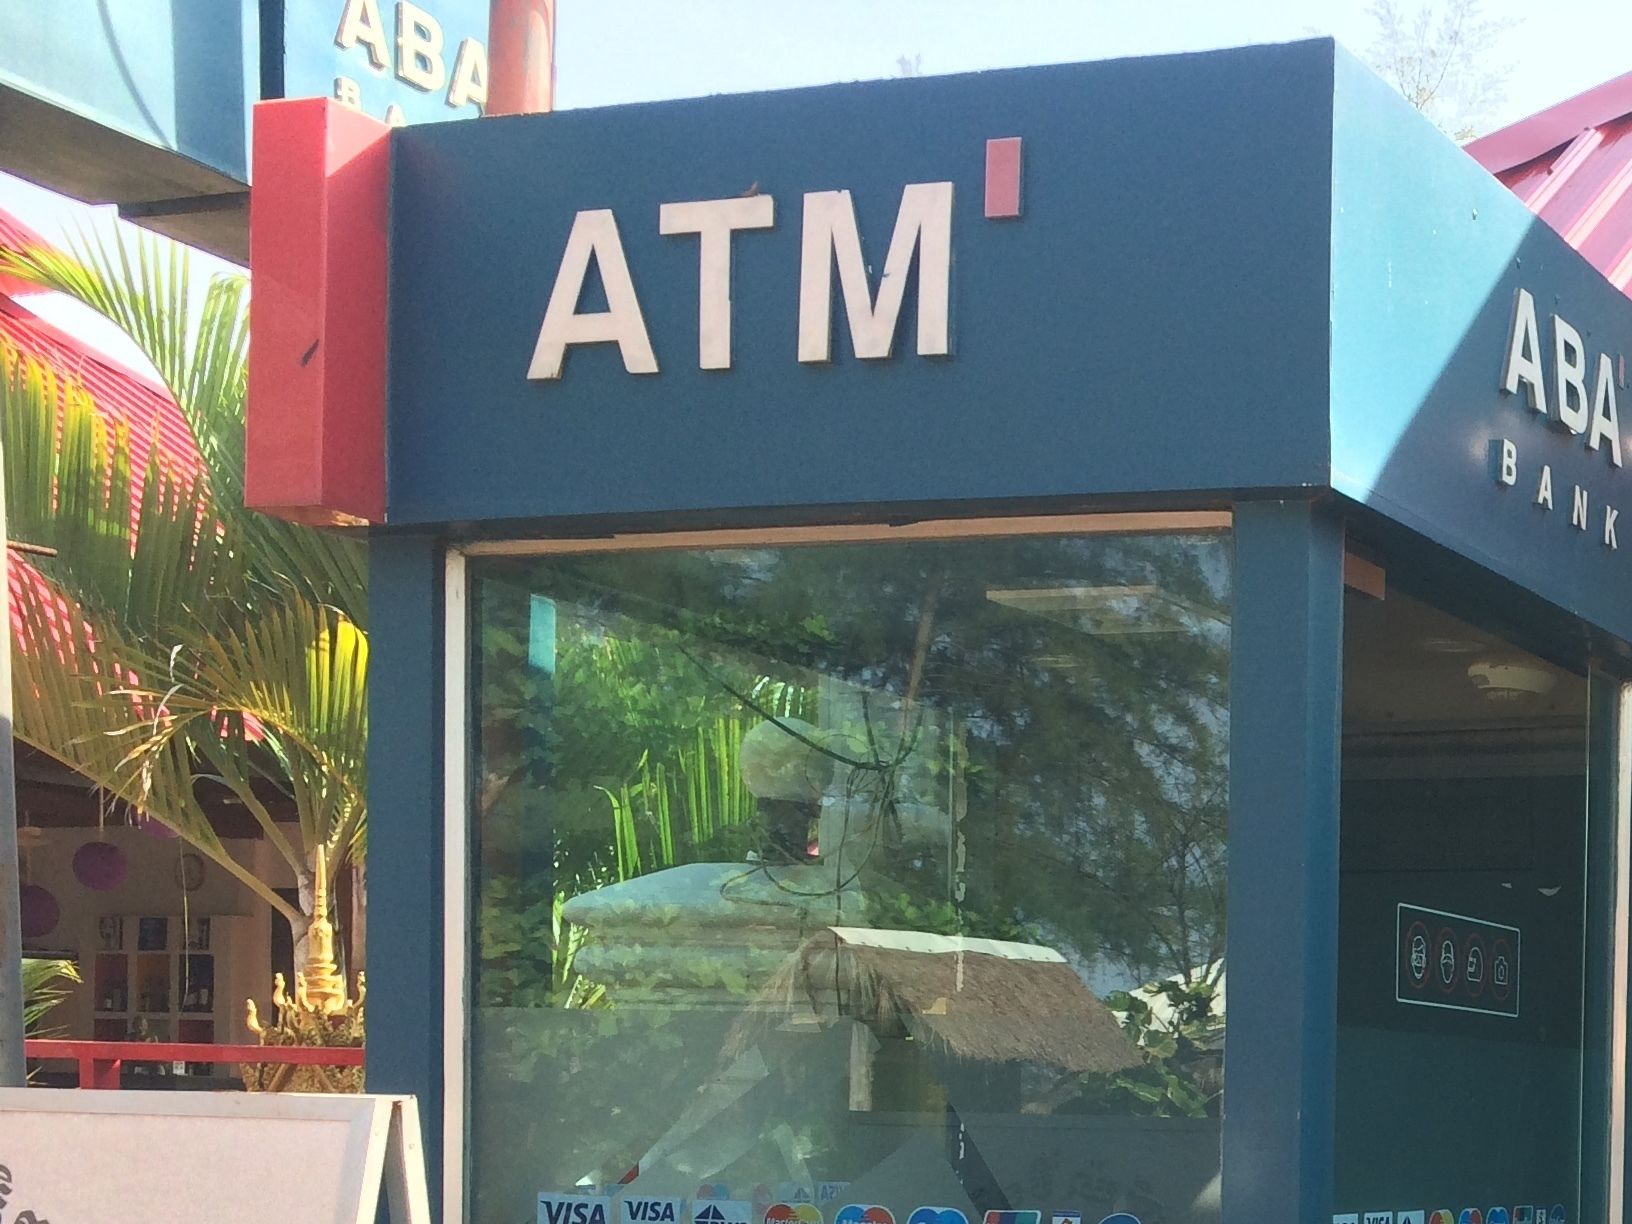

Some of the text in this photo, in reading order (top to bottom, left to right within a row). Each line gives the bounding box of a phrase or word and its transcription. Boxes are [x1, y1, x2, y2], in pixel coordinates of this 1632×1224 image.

[333, 0, 489, 117] ABA
[527, 181, 954, 381] ATM
[1501, 287, 1623, 468] ABA
[1500, 438, 1619, 550] BANK
[624, 1200, 675, 1222] VISA
